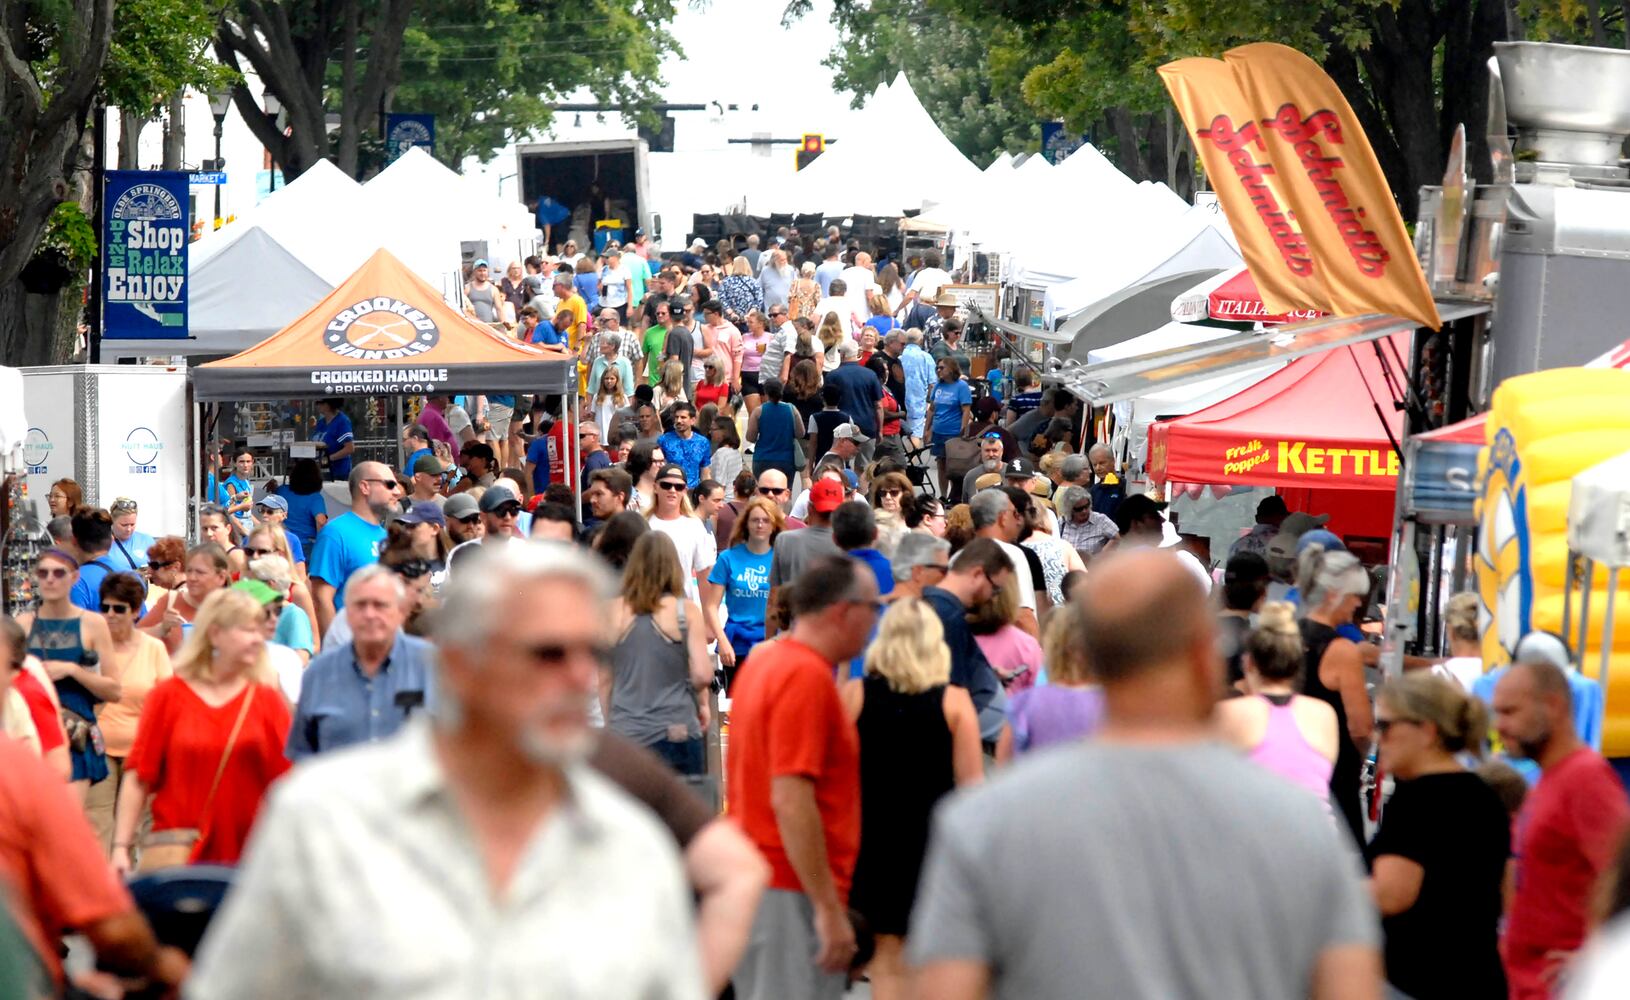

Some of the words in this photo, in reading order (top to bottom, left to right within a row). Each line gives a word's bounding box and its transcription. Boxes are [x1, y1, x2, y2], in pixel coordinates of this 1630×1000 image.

[188, 173, 218, 183] MARKET
[1262, 103, 1391, 278] Schmidt's
[114, 194, 131, 218] OLDE
[130, 186, 179, 219] SPRINGBORO
[108, 219, 127, 267] DINE
[128, 220, 184, 255] Shop
[128, 250, 184, 275] Relax
[108, 268, 184, 301] Enjoy
[327, 297, 435, 331] CROOKED
[1216, 300, 1268, 315] ITALIA
[330, 341, 432, 359] HANDLE
[311, 370, 384, 384] CROOKED
[385, 368, 448, 382] HANDLE
[335, 384, 399, 393] BREWING
[1224, 450, 1271, 476] Popped
[1225, 439, 1262, 461] Fresh
[1277, 441, 1398, 476] KETTLE
